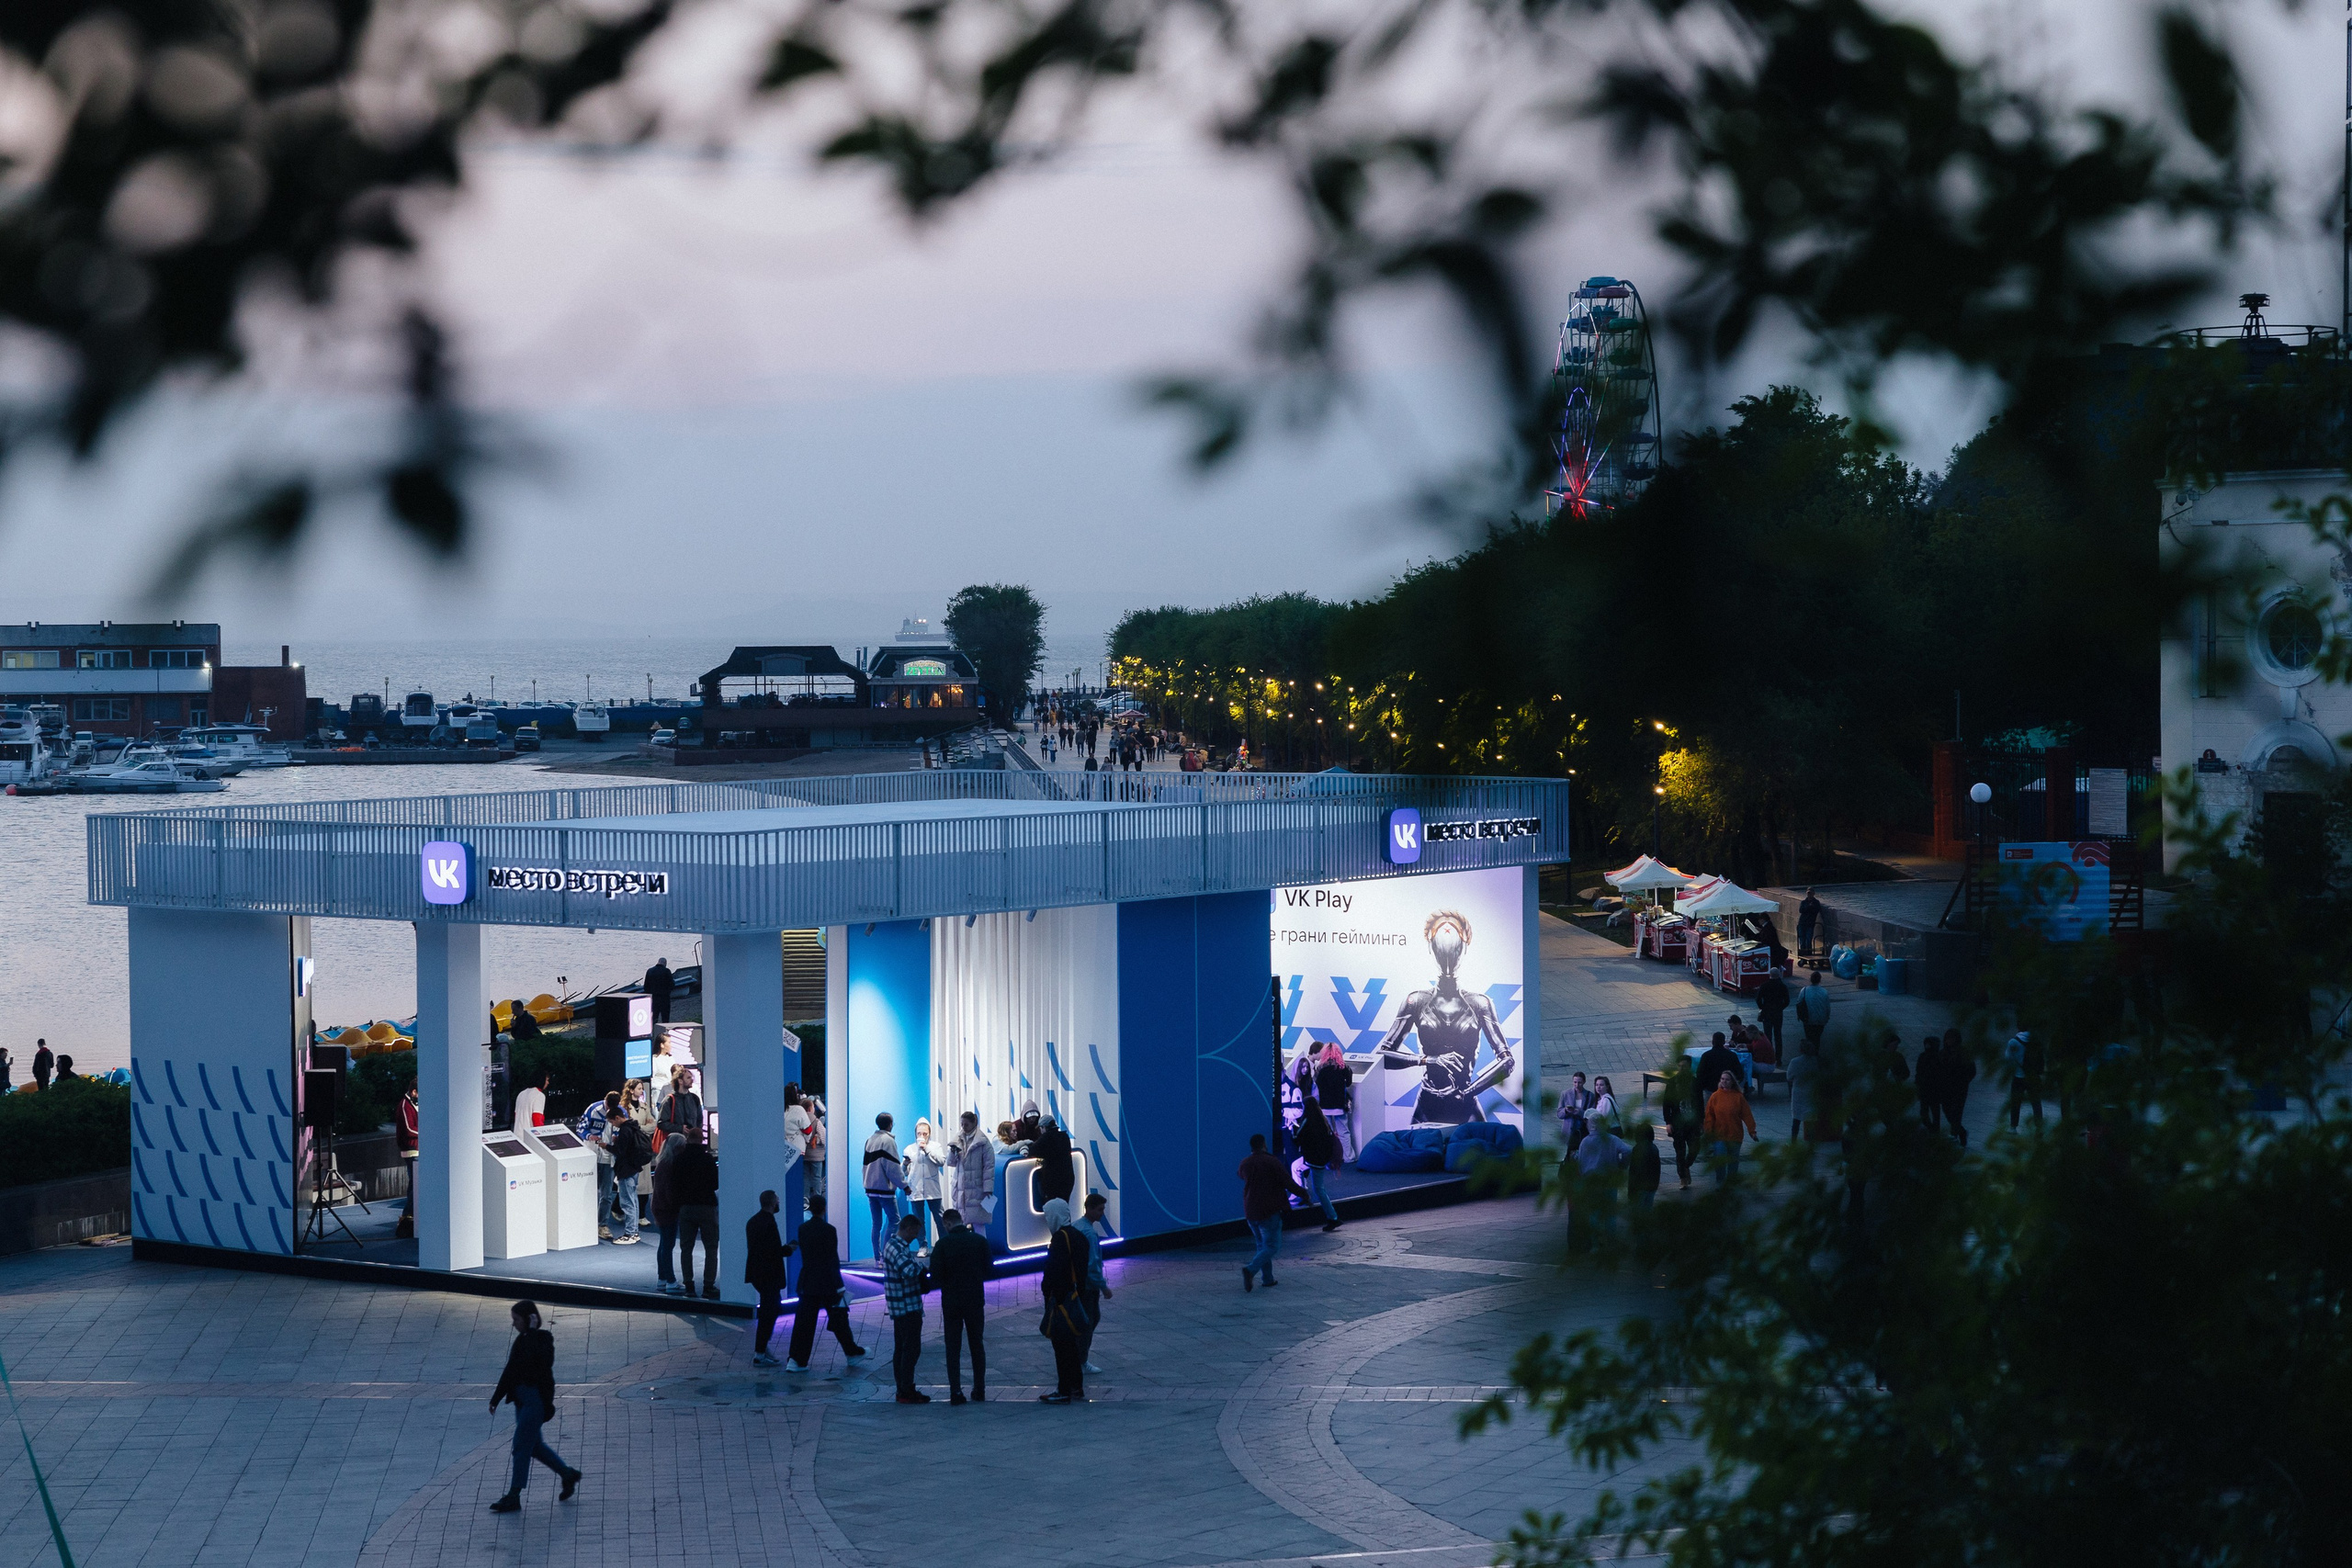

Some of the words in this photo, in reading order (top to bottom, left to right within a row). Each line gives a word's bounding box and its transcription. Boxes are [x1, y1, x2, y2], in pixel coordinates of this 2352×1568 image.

[1394, 823, 1418, 849] VK
[427, 859, 460, 888] VK
[488, 866, 565, 892] место
[565, 869, 669, 900] встречи
[1284, 888, 1311, 908] VK
[1315, 889, 1353, 913] Play
[1281, 930, 1327, 946] грани
[1331, 928, 1408, 947] гейминга
[593, 1121, 605, 1129] JUST
[525, 1179, 543, 1187] Музыка
[577, 1171, 594, 1179] Музыка
